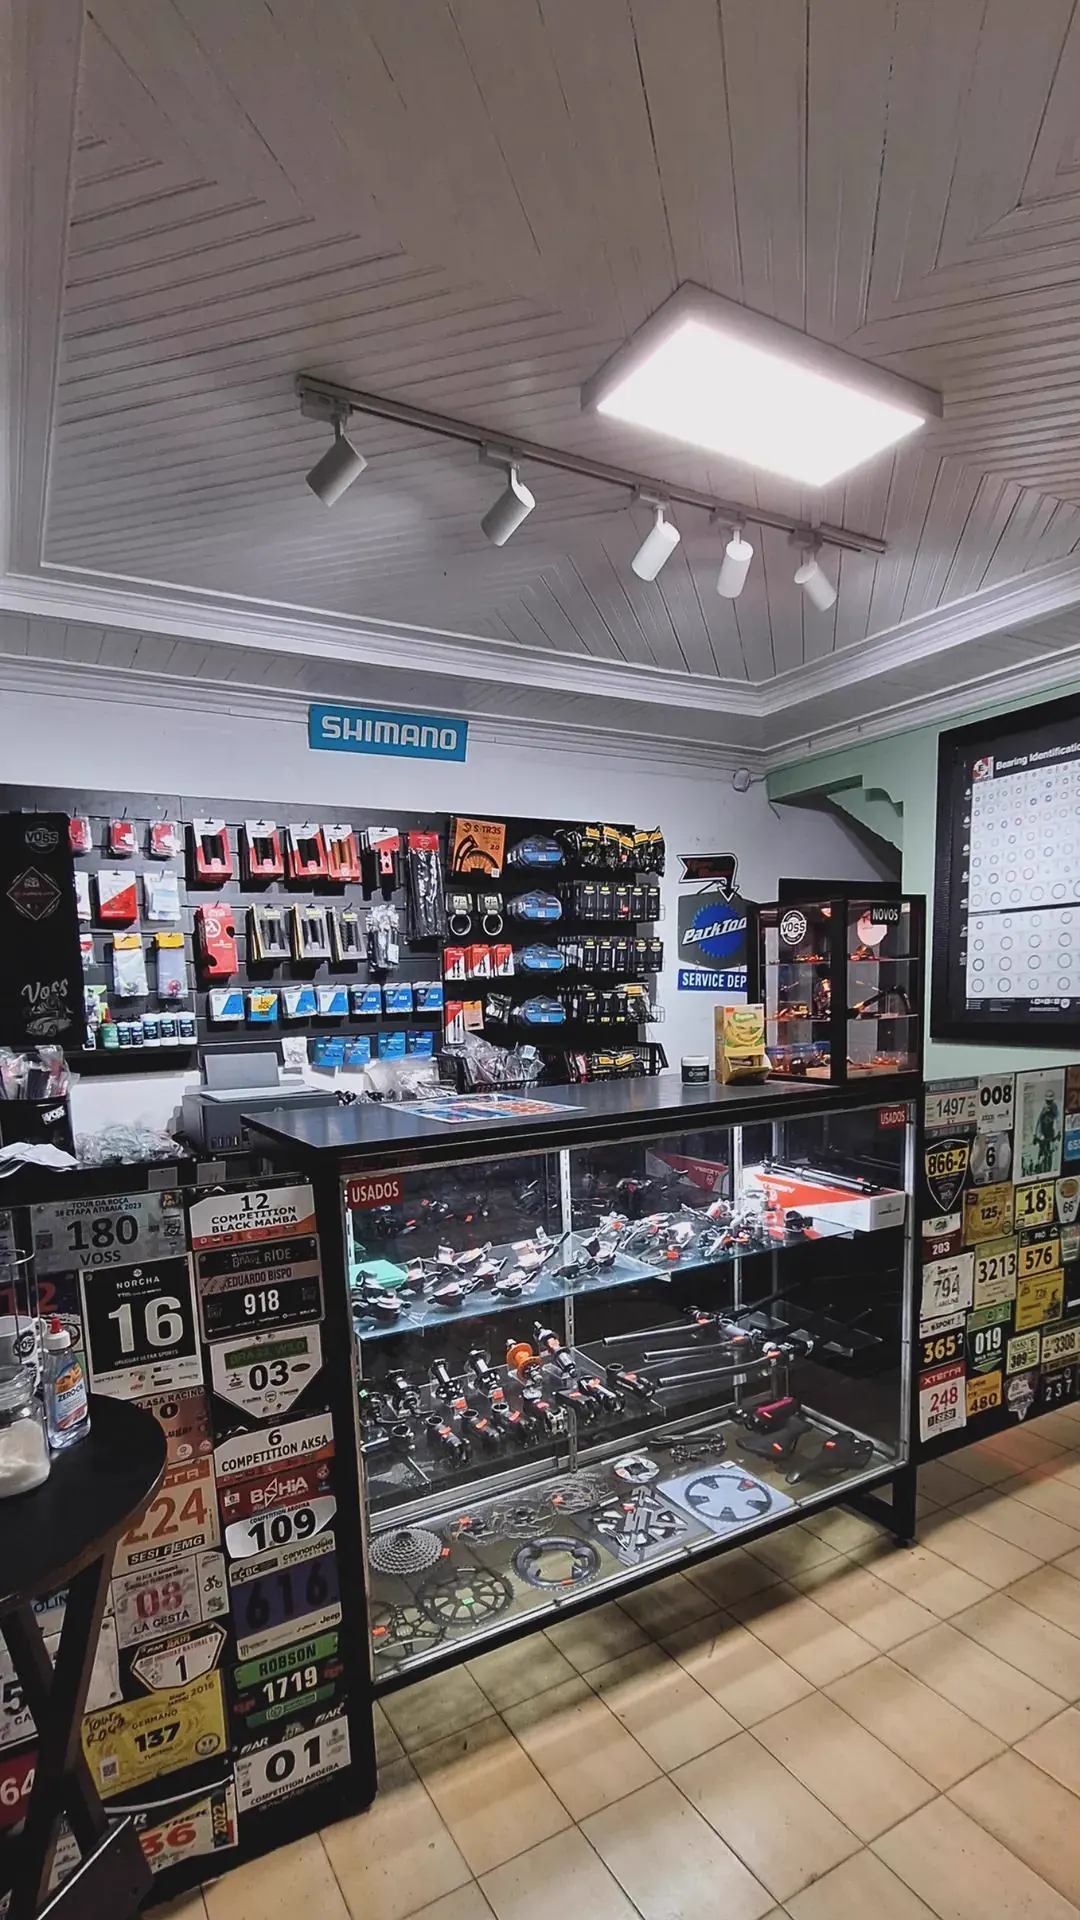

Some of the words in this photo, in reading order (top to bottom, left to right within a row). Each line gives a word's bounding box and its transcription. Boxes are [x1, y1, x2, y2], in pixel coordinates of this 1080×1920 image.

[321, 715, 458, 750] SHIMANO
[996, 755, 1029, 771] Bearing
[25, 830, 59, 844] VOSS
[872, 907, 899, 921] NOVOS
[682, 917, 747, 945] ParkToo
[782, 920, 806, 934] VOSS
[682, 972, 724, 988] SERVICE
[727, 974, 747, 988] DEP
[980, 1084, 1012, 1107] 008
[880, 1110, 905, 1125] USADOS
[936, 1097, 966, 1118] 1497
[927, 1149, 966, 1176] 866-2
[985, 1146, 996, 1168] 6
[241, 1193, 270, 1212] 12
[352, 1180, 399, 1203] USADOS
[1025, 1189, 1047, 1215] 18
[124, 1202, 142, 1211] 2023
[211, 1206, 296, 1224] COMPETITION
[980, 1206, 997, 1220] 125
[67, 1215, 138, 1251] 180
[212, 1221, 251, 1234] BLACK
[255, 1214, 298, 1228] MAMBA
[80, 1250, 121, 1266] VOSS
[264, 1248, 292, 1263] RIDE
[932, 1241, 950, 1256] 203
[1025, 1246, 1053, 1271] 576
[228, 1272, 267, 1288] EDUARDO
[267, 1267, 292, 1281] BISPO
[978, 1253, 1016, 1284] 3213
[116, 1276, 160, 1289] NORCHA
[932, 1274, 960, 1298] 794
[244, 1289, 280, 1316] 918
[108, 1296, 184, 1353] 16
[975, 1327, 1002, 1355] 019
[249, 1360, 290, 1391] 03
[923, 1367, 962, 1386] XTERRA
[930, 1386, 959, 1413] 248
[970, 1392, 998, 1413] 480
[268, 1429, 282, 1446] 6
[221, 1442, 298, 1472] COMPETITION
[301, 1435, 329, 1454] AKSA
[250, 1508, 287, 1524] COMPETITION
[247, 1508, 316, 1551] 109
[130, 1549, 159, 1565] SESI
[283, 1538, 334, 1561] cannondale
[136, 1580, 184, 1620] 08
[246, 1560, 328, 1629] 616
[133, 1623, 150, 1635] LA
[152, 1609, 190, 1630] GESTA
[320, 1612, 341, 1624] Jeep
[175, 1655, 188, 1682] 1
[259, 1644, 317, 1677] ROBSON
[191, 1681, 215, 1697] 2016
[262, 1666, 318, 1704] 1719
[2, 1679, 25, 1717] 5
[132, 1709, 178, 1730] GERMANO
[134, 1721, 181, 1753] 137
[241, 1737, 269, 1756] FIAR
[265, 1735, 321, 1785] 01
[251, 1777, 305, 1806] COMPETITION
[304, 1763, 340, 1783] AROEIRA
[213, 1803, 227, 1835] 2022
